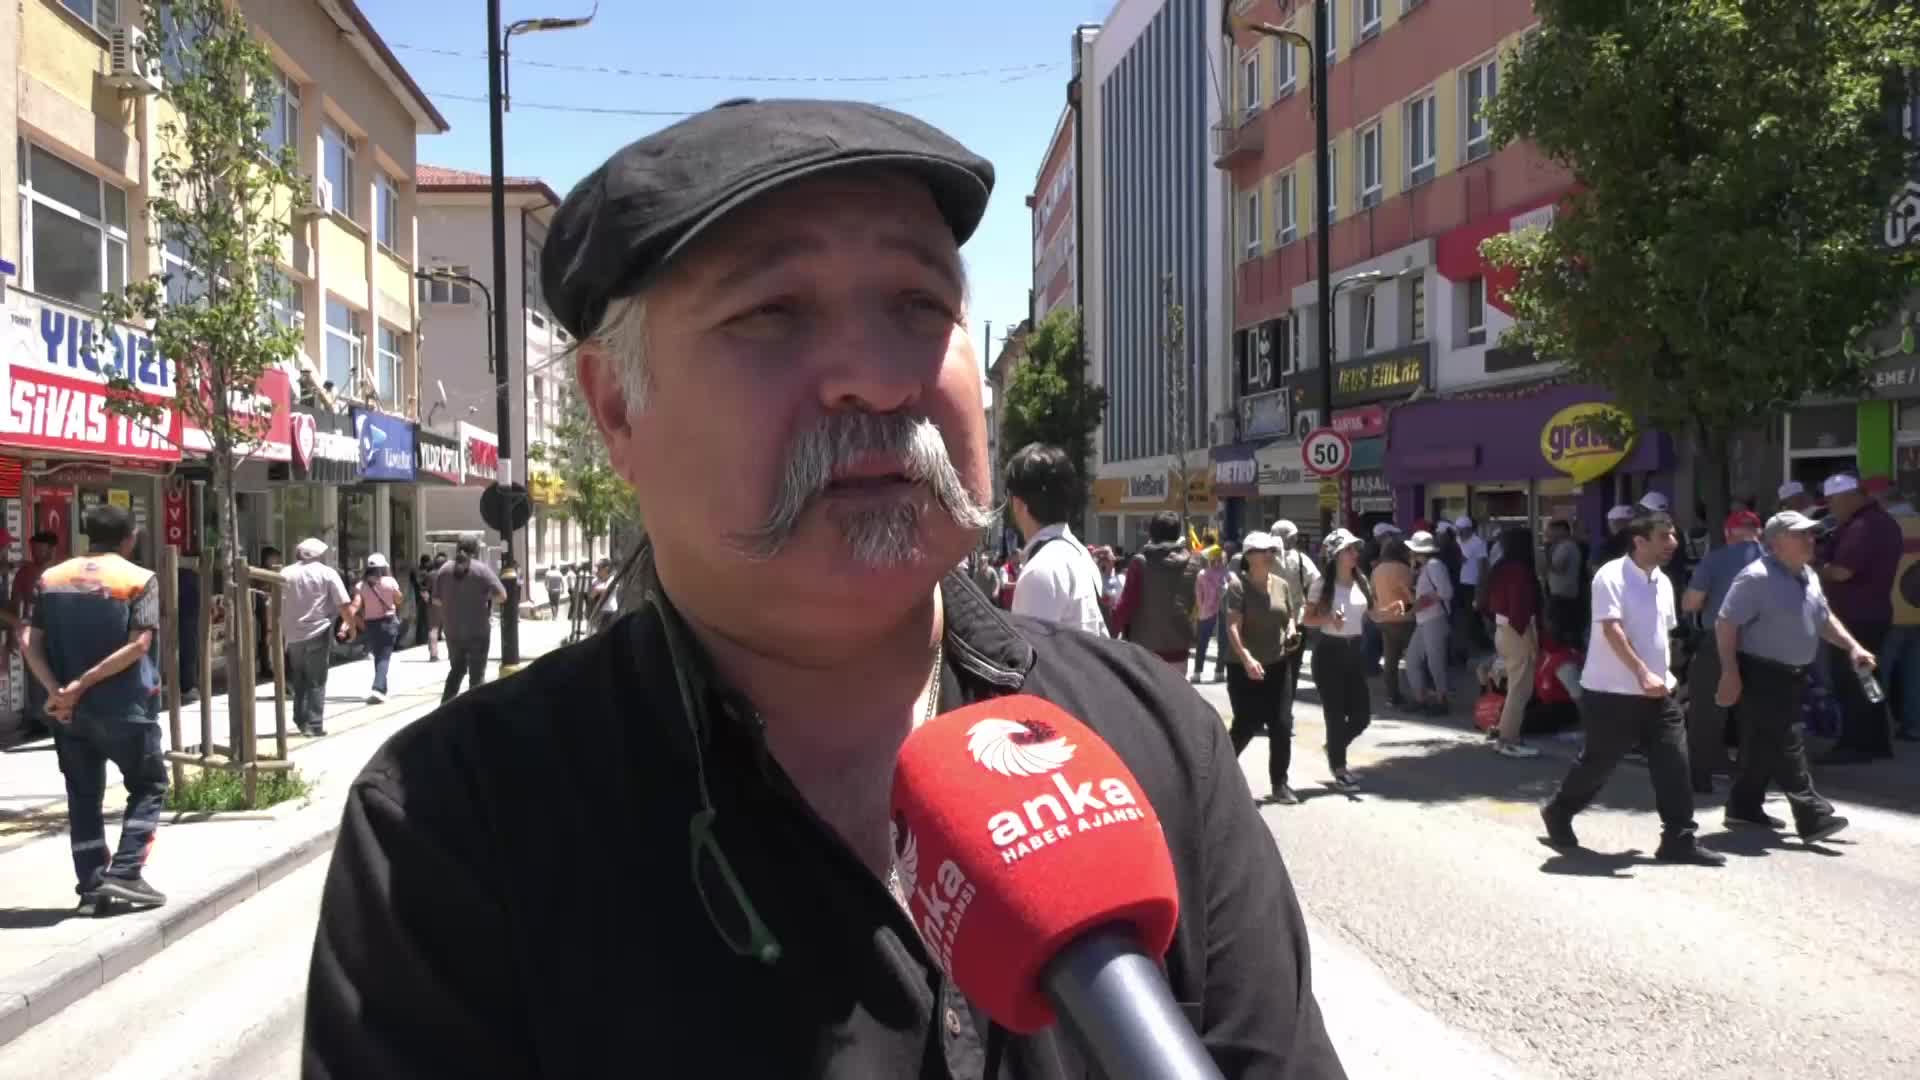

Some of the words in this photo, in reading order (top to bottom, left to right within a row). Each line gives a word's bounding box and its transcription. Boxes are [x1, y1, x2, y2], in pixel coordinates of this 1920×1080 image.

[1314, 443, 1339, 464] 50
[987, 772, 1136, 846] anka
[1001, 824, 1072, 864] HABER
[1077, 807, 1145, 832] AJANSI
